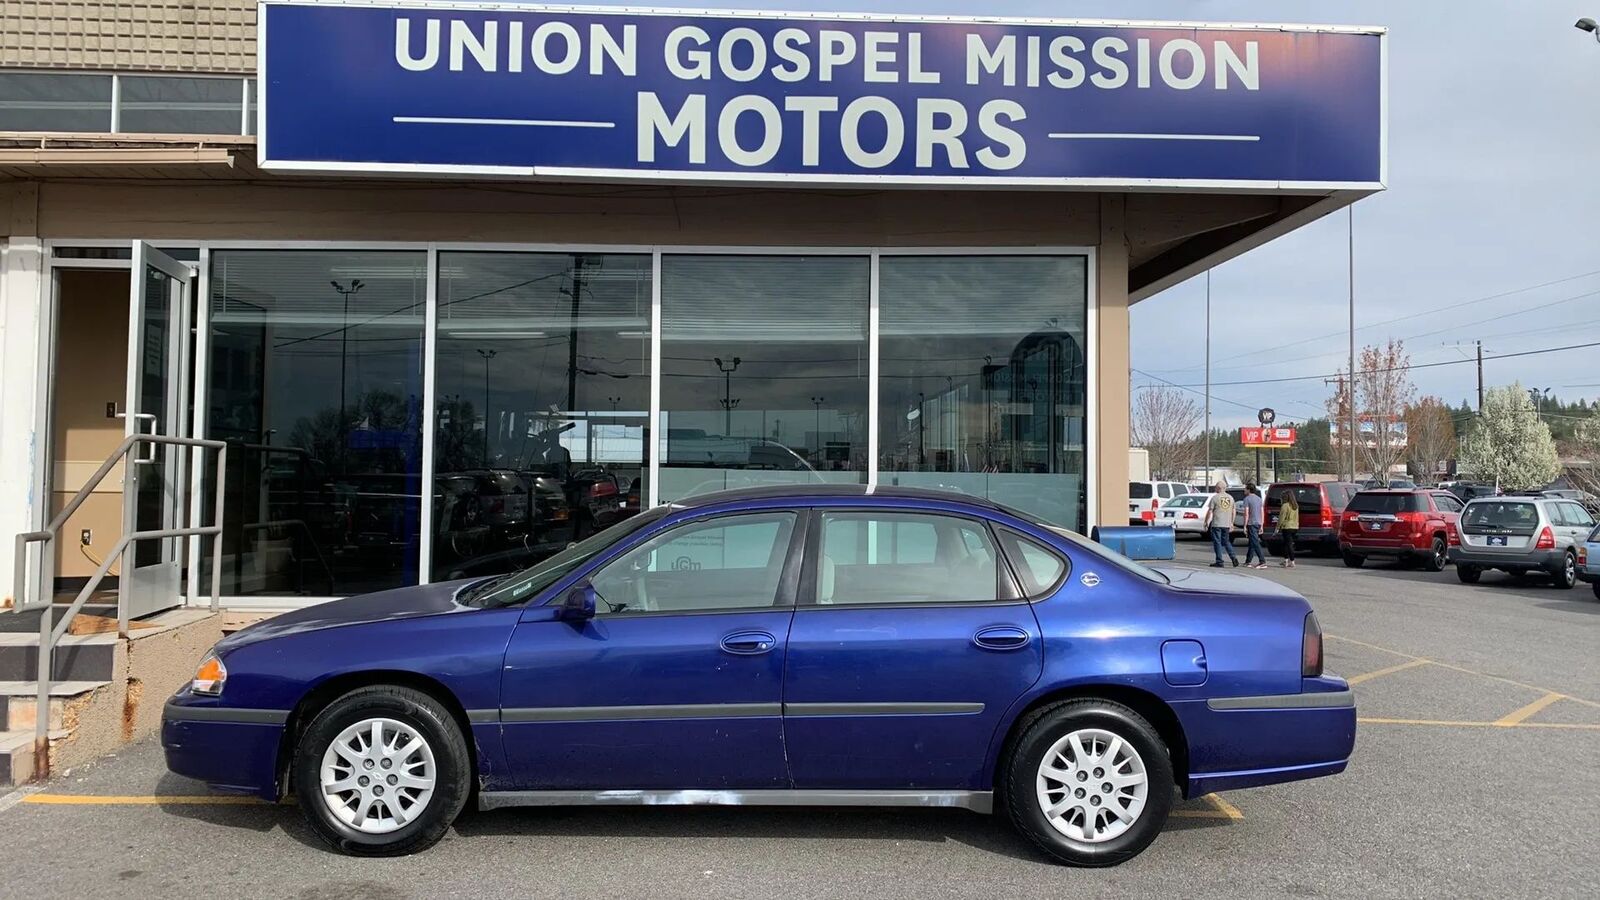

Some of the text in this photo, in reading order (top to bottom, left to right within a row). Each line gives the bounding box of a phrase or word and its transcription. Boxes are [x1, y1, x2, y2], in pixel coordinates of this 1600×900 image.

[395, 18, 1260, 91] UNION GOSPEL MISSION
[637, 91, 1027, 170] MOTORS
[1246, 432, 1259, 441] VIP
